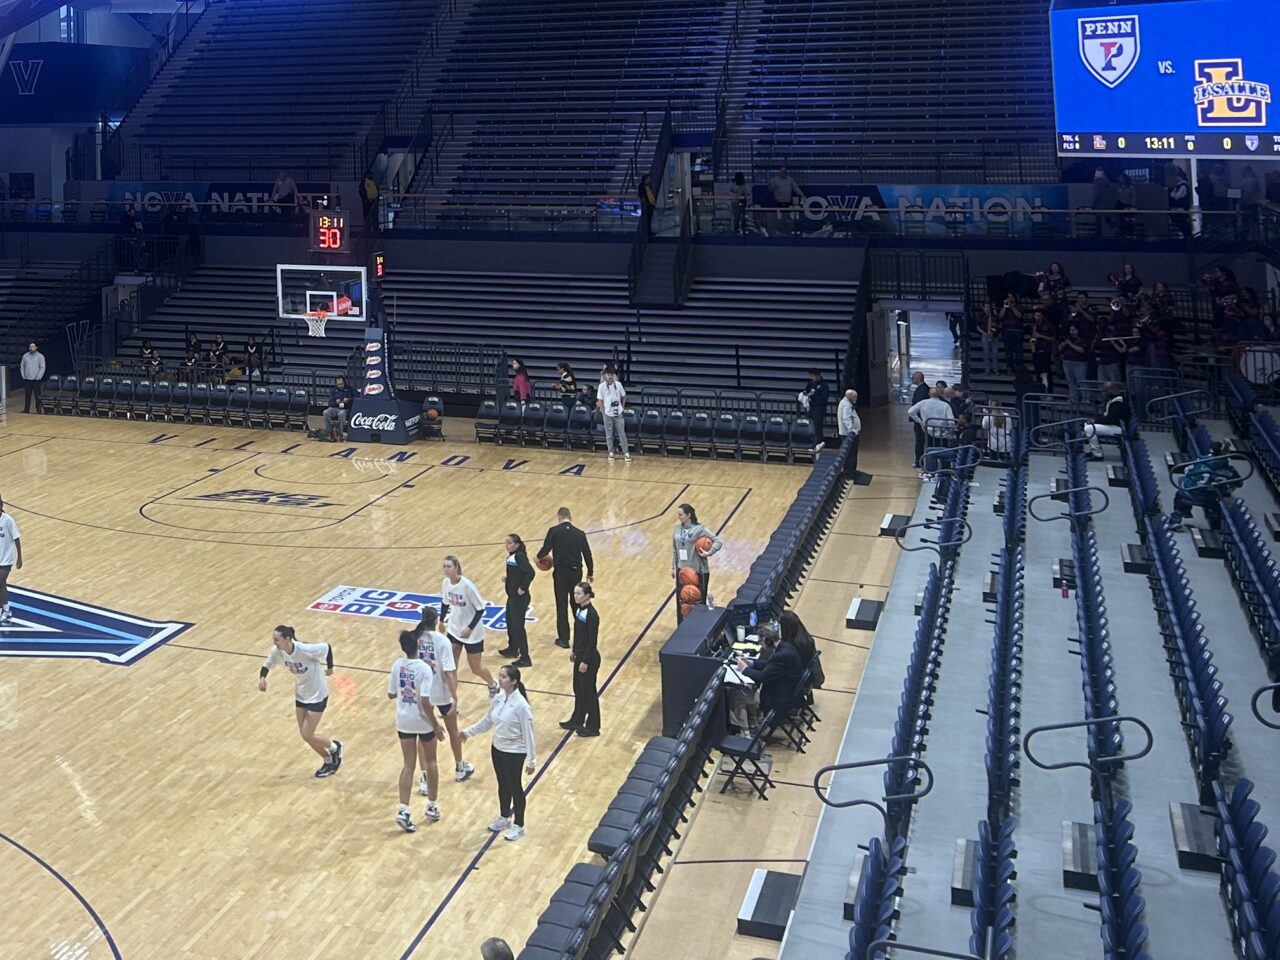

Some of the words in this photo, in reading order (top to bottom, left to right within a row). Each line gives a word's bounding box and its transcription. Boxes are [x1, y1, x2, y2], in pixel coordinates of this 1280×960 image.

[1084, 21, 1133, 36] PENN
[1157, 60, 1177, 74] VS.
[1118, 137, 1126, 149] 0
[1145, 138, 1175, 149] 13:11
[1187, 141, 1194, 151] 0
[1223, 138, 1231, 150] 0
[124, 191, 204, 213] NOVA
[897, 196, 1043, 222] NATION
[319, 216, 344, 228] 13:11
[319, 229, 341, 248] 30
[149, 433, 587, 476] VILLANOVA
[328, 586, 358, 603] TOYOTA
[339, 589, 398, 616] BIG
[396, 601, 412, 610] 5
[400, 672, 415, 681] BIG
